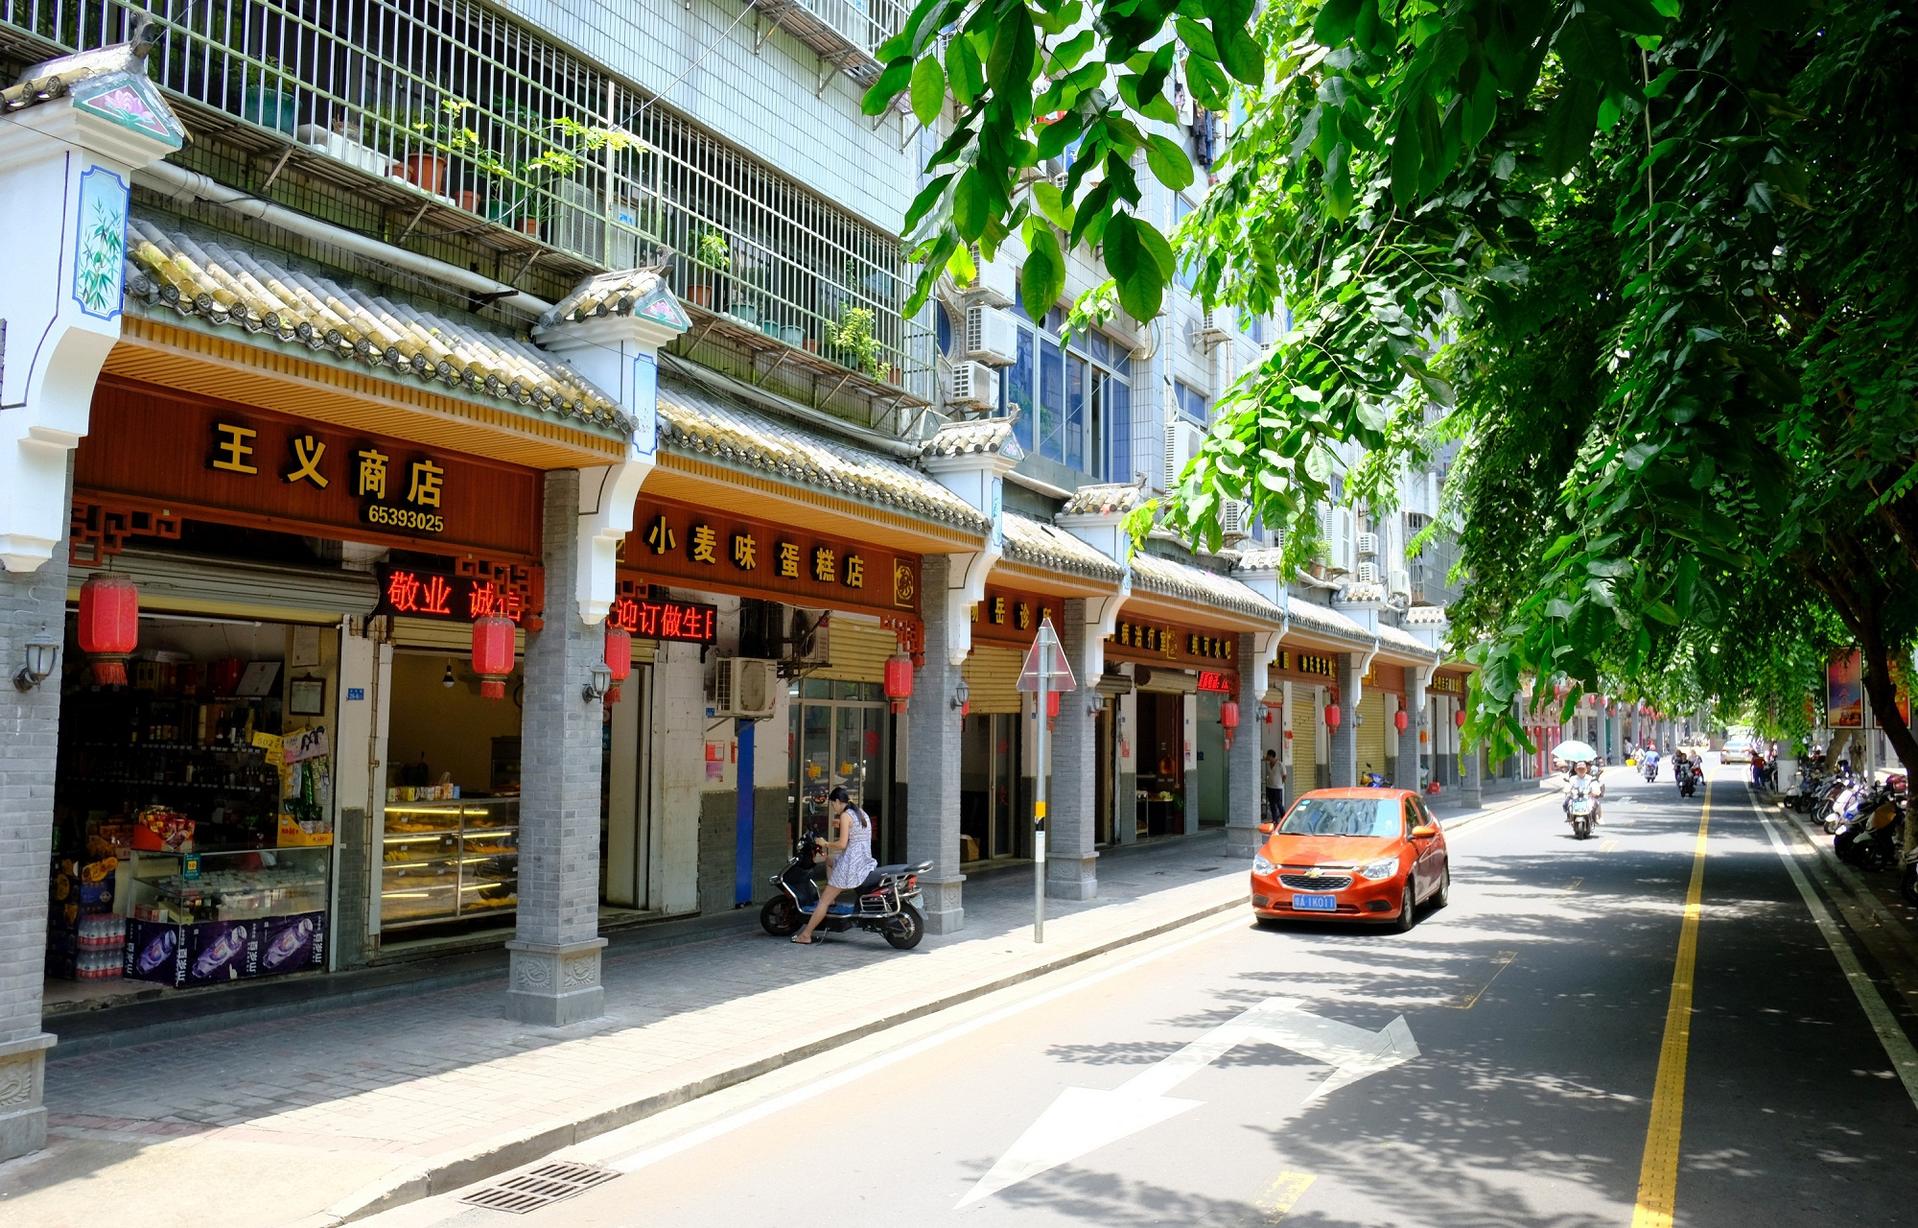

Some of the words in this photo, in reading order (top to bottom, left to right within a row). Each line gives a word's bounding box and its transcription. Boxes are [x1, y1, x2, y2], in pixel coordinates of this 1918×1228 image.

[212, 422, 445, 509] 王义商店
[368, 503, 444, 534] 65393025
[648, 514, 866, 589] 小麦味蛋糕店
[387, 570, 452, 615] 敬业
